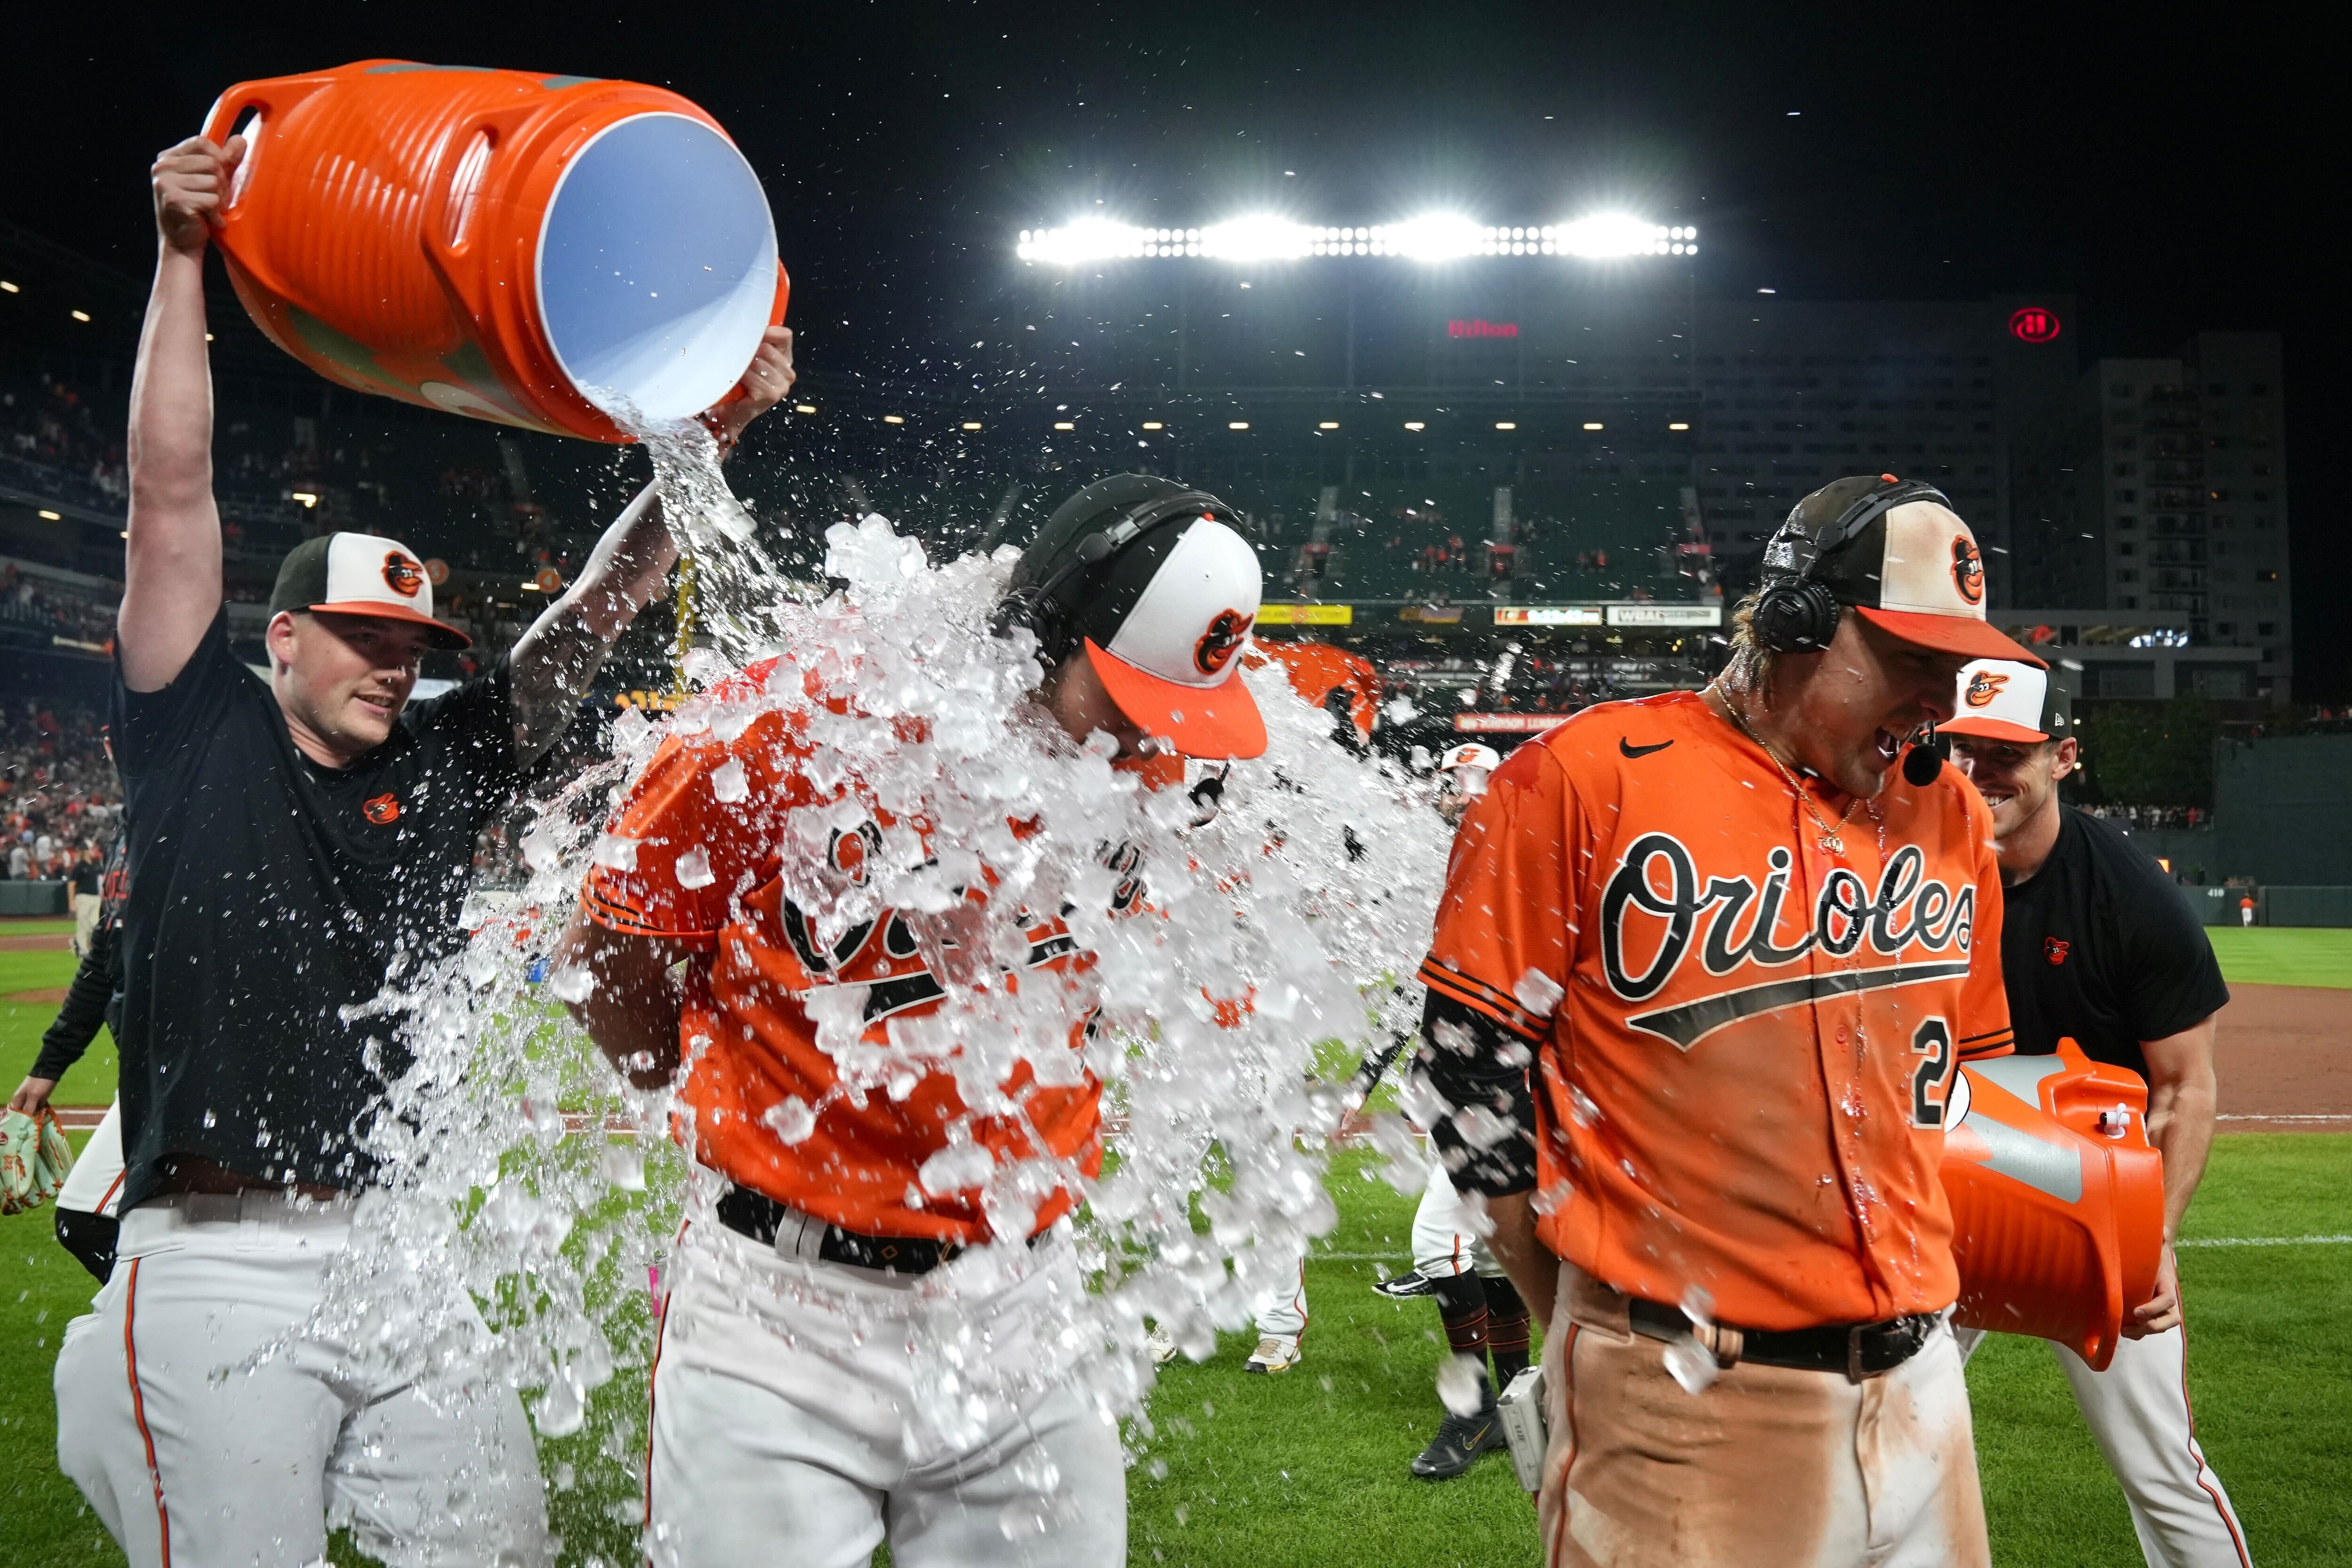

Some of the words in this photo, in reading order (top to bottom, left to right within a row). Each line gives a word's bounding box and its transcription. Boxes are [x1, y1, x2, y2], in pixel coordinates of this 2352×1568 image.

[1449, 319, 1517, 337] Hilton
[1600, 832, 1976, 1002] Orioles
[2207, 888, 2225, 897] 410
[1911, 1015, 1951, 1130] 2
